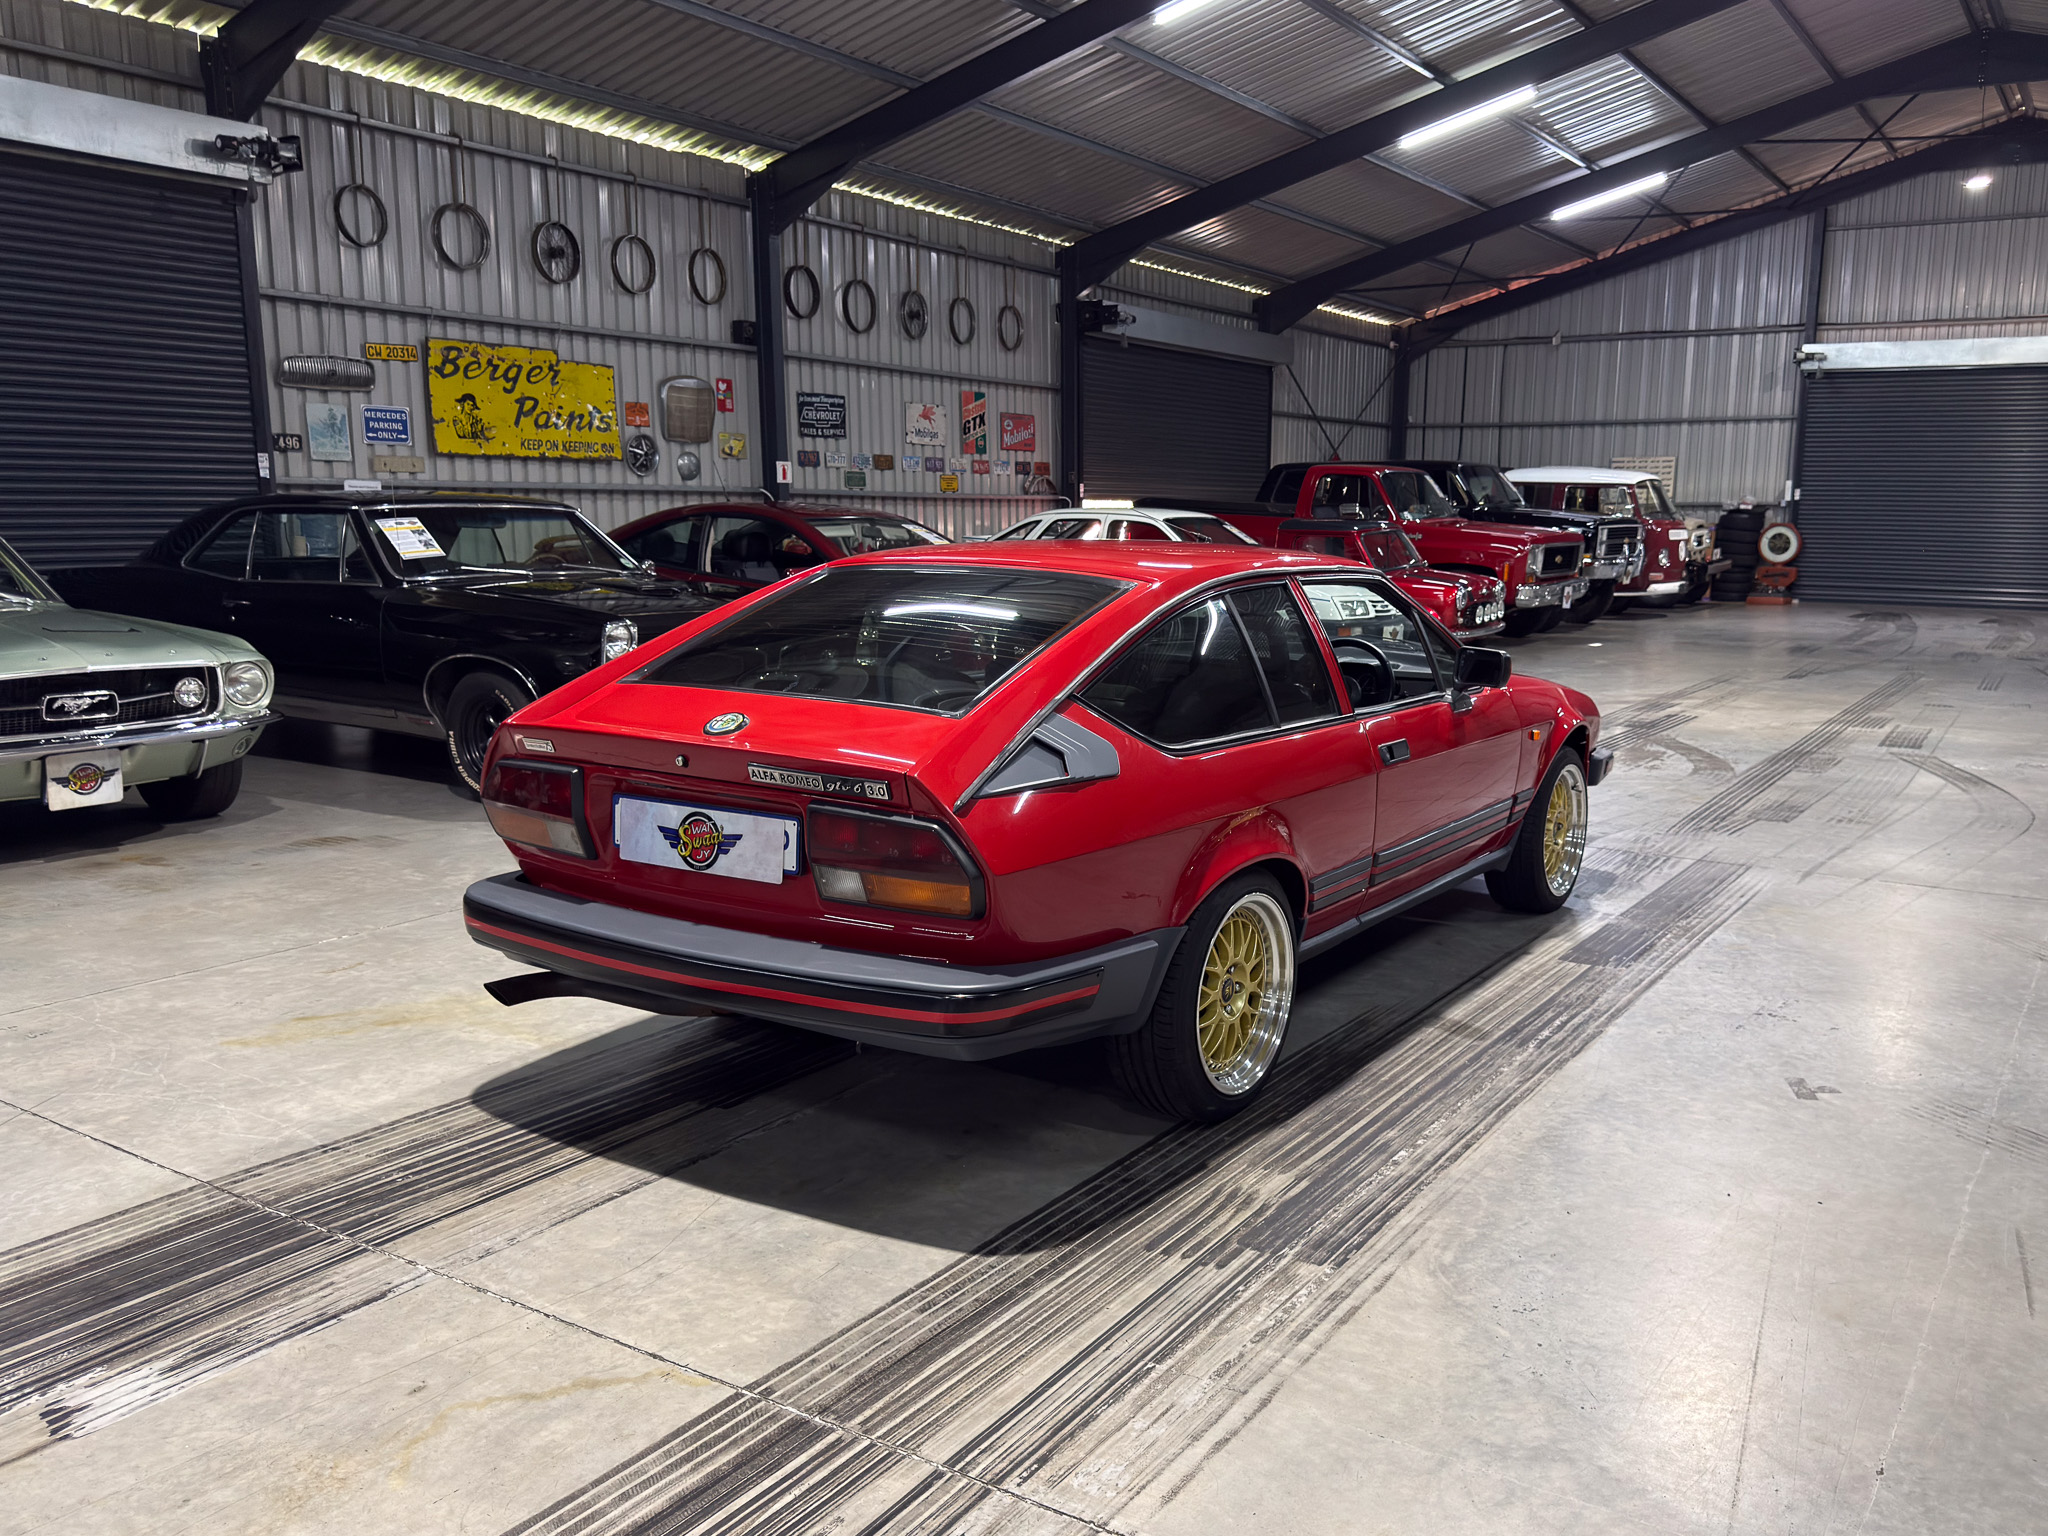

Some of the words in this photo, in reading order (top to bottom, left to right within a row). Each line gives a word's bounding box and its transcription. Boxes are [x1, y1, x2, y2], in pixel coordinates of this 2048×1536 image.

[367, 345, 382, 358] CW
[386, 346, 416, 359] 20314
[434, 345, 561, 394] Berger
[364, 410, 407, 420] MERCEDES
[514, 395, 613, 433] Paints
[804, 410, 841, 421] CHEVROLET
[369, 421, 403, 430] PARKING
[963, 411, 986, 436] GTX
[377, 431, 398, 439] ONLY
[823, 428, 845, 436] SERVICE
[914, 427, 939, 441] Mobilgas
[1003, 423, 1034, 447] Mobiloil
[520, 438, 543, 451] KEEP
[545, 439, 559, 452] ON
[562, 440, 599, 453] KEEPING
[601, 442, 615, 454] ON
[751, 769, 778, 783] ALFA
[779, 772, 820, 788] ROMEO
[853, 783, 862, 793] 6
[866, 785, 885, 797] 3.0
[691, 820, 715, 835] WAT
[677, 824, 725, 857] Swaai
[696, 849, 711, 859] JY
